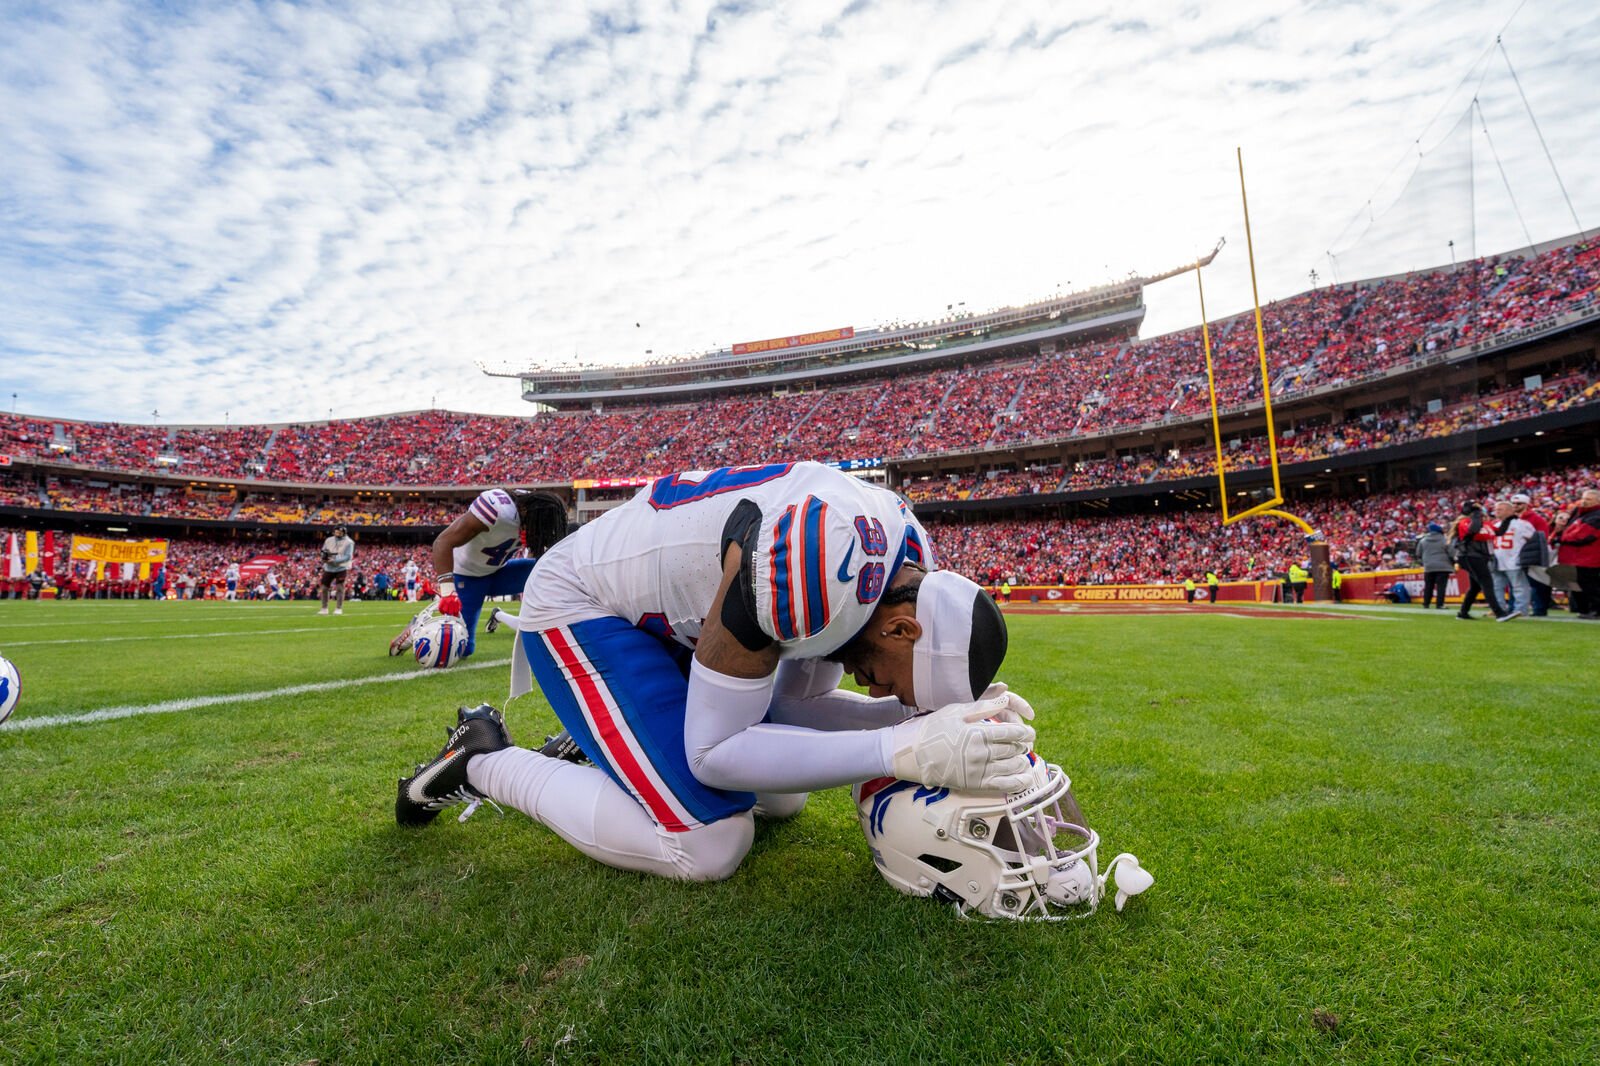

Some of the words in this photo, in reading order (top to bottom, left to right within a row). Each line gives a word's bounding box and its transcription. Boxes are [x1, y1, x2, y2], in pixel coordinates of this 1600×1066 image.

[746, 340, 768, 352] SUPER
[769, 338, 788, 350] BOWL
[800, 329, 841, 345] CHAMPIONS
[93, 543, 107, 558] GO
[111, 544, 149, 560] CHIEFS
[1073, 588, 1117, 600] CHIEFS
[1118, 588, 1185, 600] KINGDOM
[1008, 787, 1036, 804] OAKLEY
